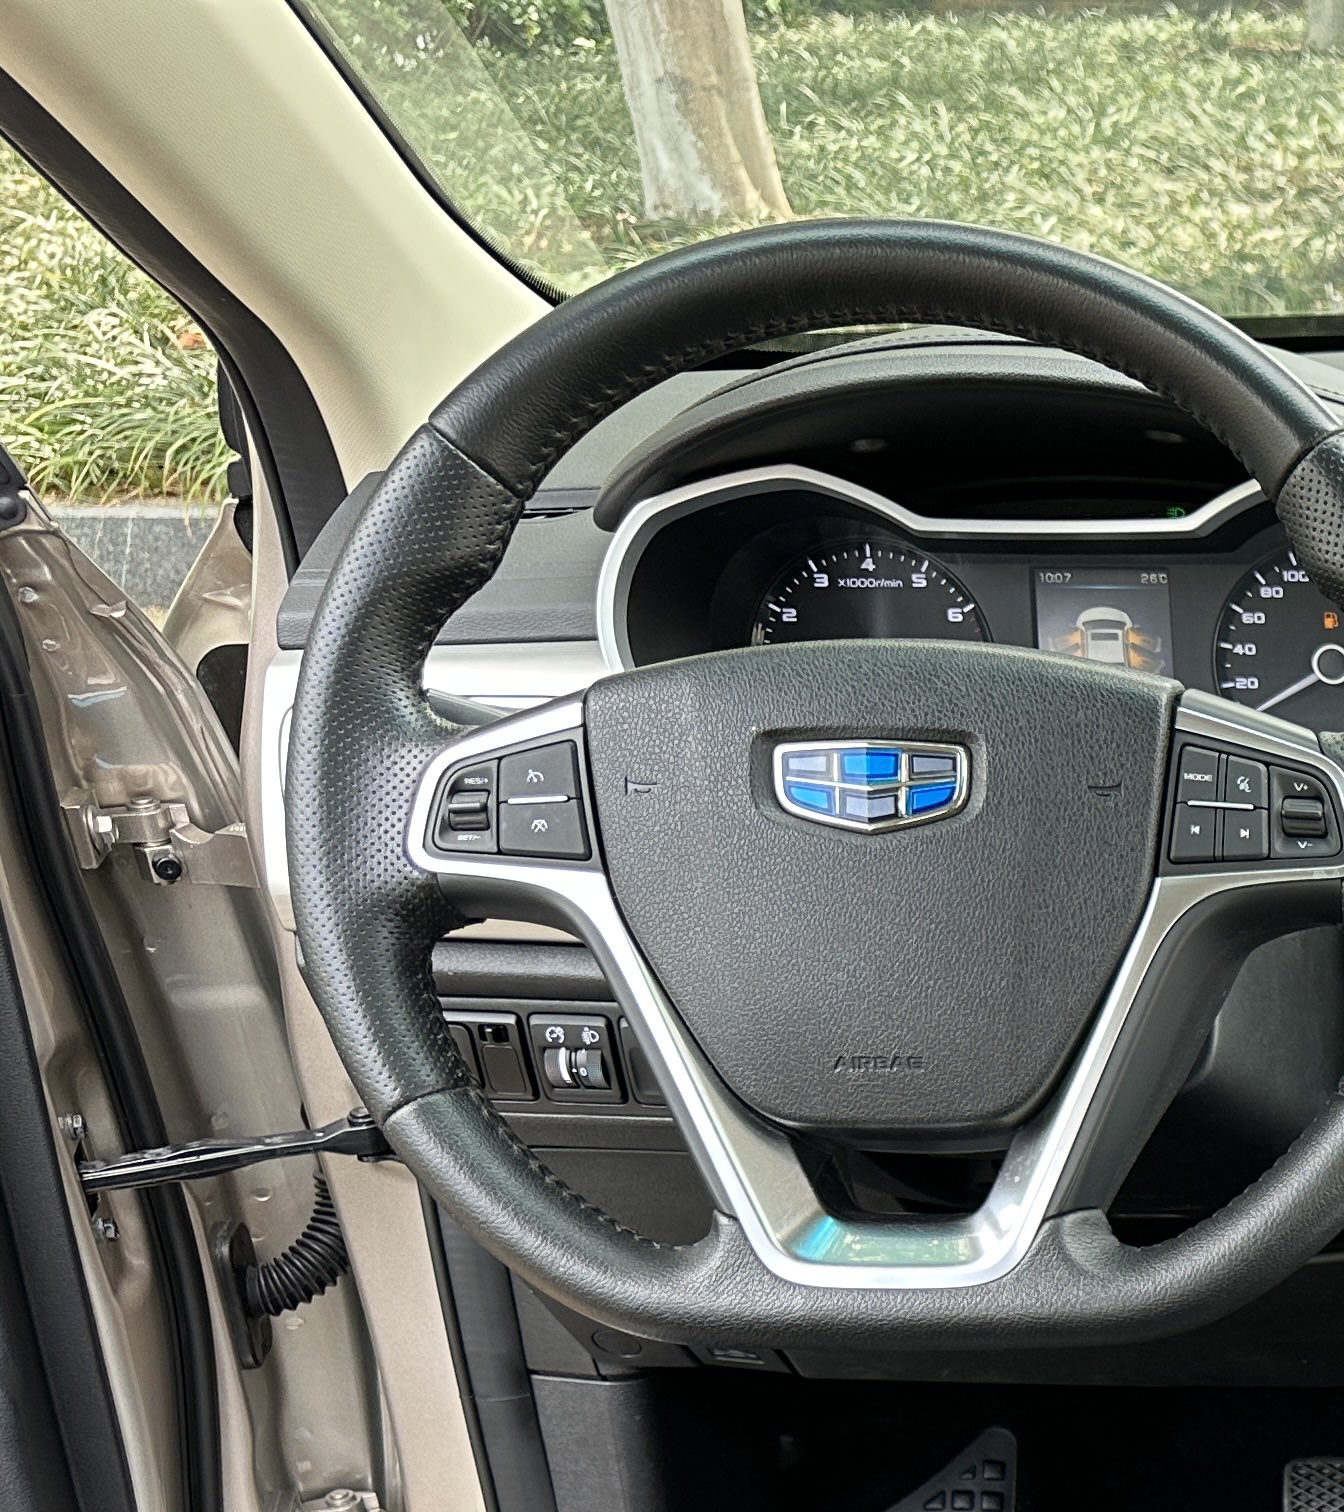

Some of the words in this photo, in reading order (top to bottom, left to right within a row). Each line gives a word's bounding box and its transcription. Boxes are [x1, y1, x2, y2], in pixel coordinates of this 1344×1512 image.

[860, 558, 876, 571] 4
[813, 573, 829, 587] 3
[911, 573, 927, 587] 5
[1260, 586, 1284, 598] 80
[781, 608, 798, 622] 2
[947, 608, 964, 622] 6
[1241, 612, 1266, 624] 60
[1232, 643, 1257, 655] 40
[1235, 677, 1259, 689] 20
[1183, 772, 1212, 782] MODE
